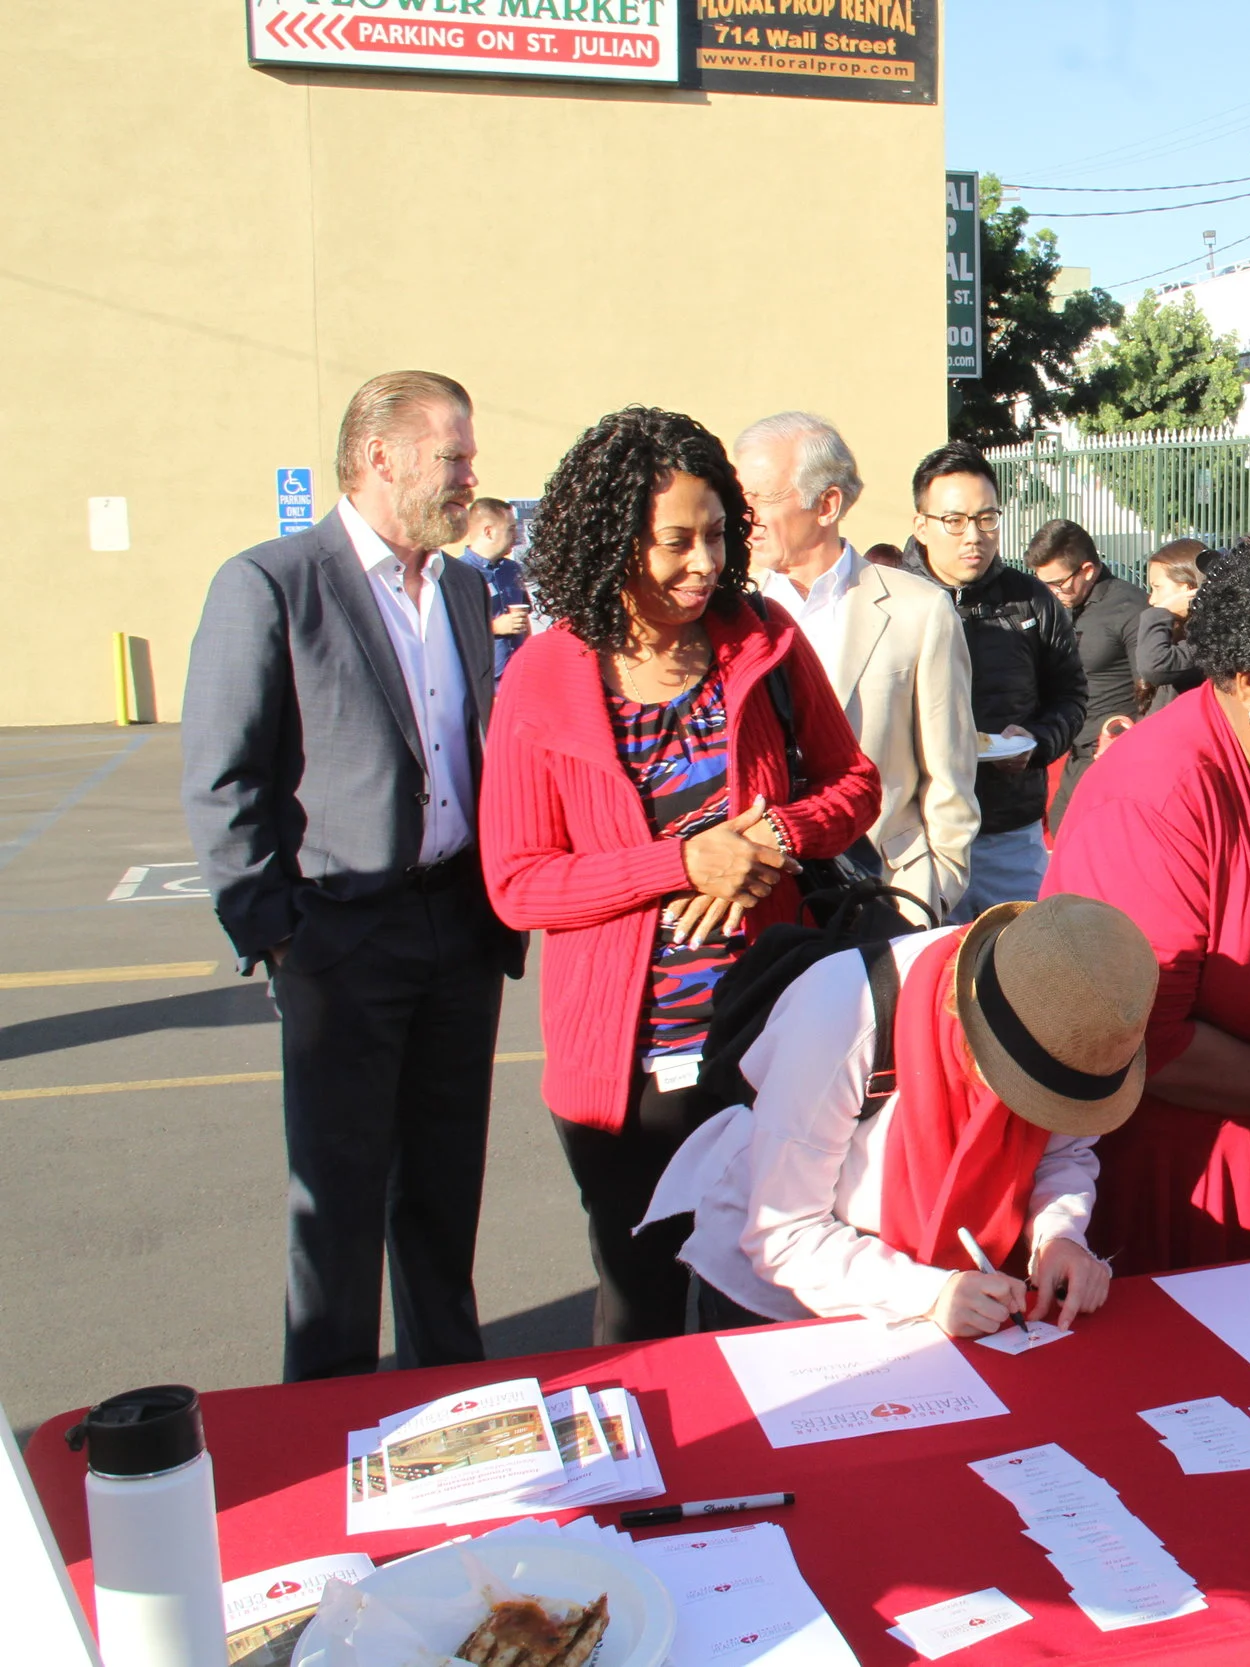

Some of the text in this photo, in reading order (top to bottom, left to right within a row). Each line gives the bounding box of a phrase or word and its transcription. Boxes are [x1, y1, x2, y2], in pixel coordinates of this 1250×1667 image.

[840, 0, 916, 36] RENTAL
[358, 22, 653, 60] PARKING ON ST. JULIAN
[714, 25, 897, 56] 714 Wall Street
[703, 53, 909, 76] www.floralprop.com
[280, 495, 311, 505] PARKING
[286, 507, 306, 517] ONLY
[788, 1361, 859, 1377] WILLIAMS
[823, 1367, 891, 1382] CHECK IN
[911, 1394, 976, 1413] HEALTH
[953, 1404, 980, 1413] LOS
[790, 1410, 871, 1431] CENTERS
[881, 1409, 945, 1423] ANGELES
[795, 1419, 875, 1436] CHRISTIAN
[704, 1503, 735, 1514] Sharpie
[712, 1623, 795, 1656] HEALTH CENTERS
